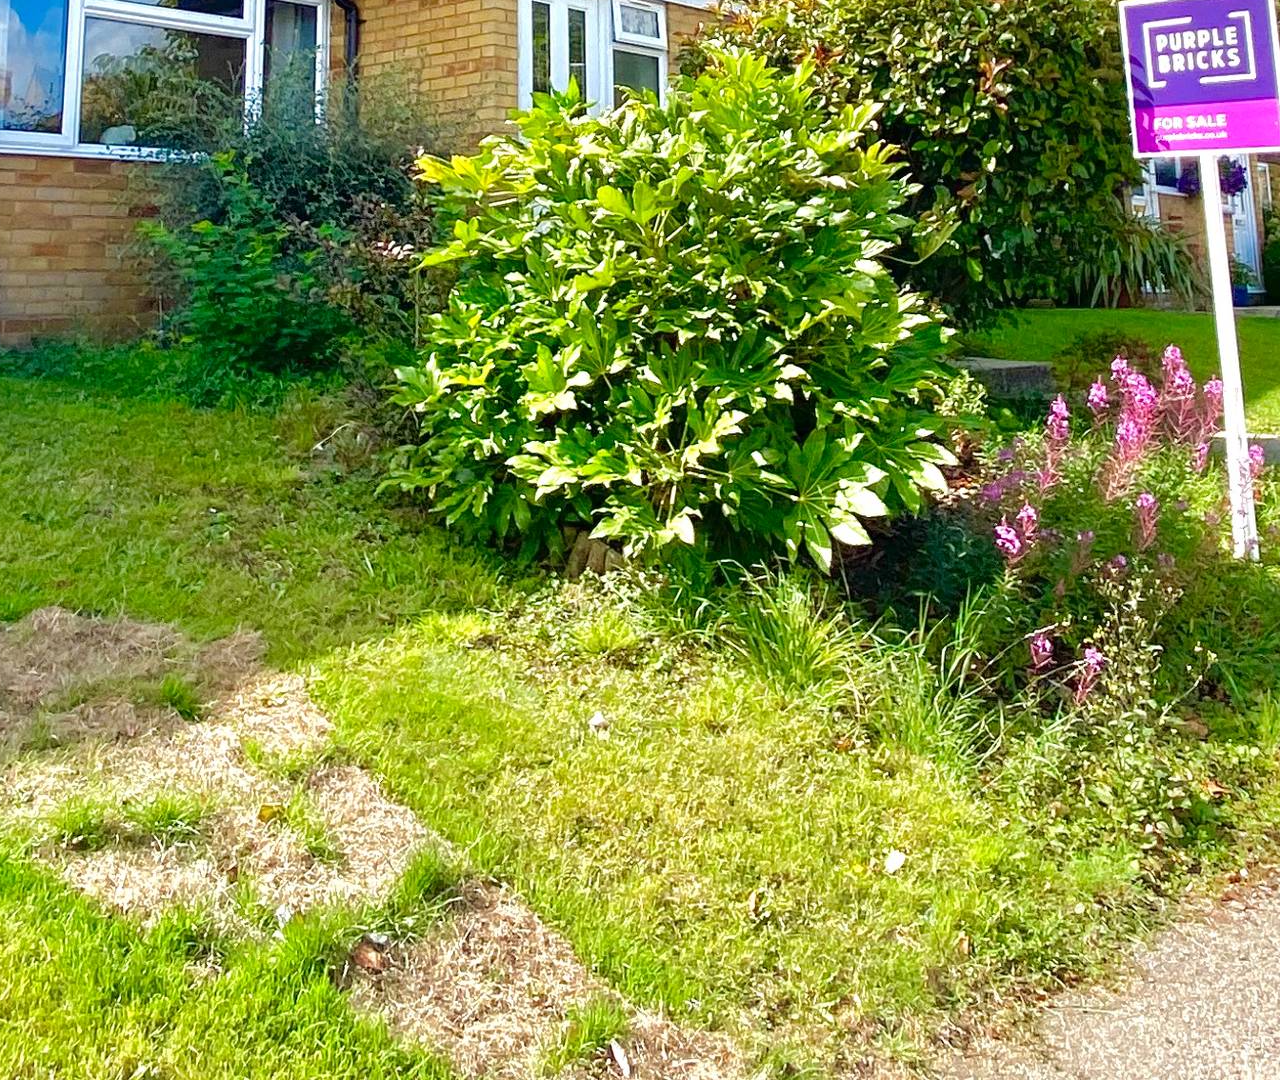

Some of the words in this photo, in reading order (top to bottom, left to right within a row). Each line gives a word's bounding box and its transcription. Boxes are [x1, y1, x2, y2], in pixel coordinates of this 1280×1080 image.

[1155, 26, 1238, 53] PURPLE
[1157, 48, 1241, 74] BRICKS
[1153, 116, 1183, 130] FOR
[1185, 114, 1227, 128] SALE
